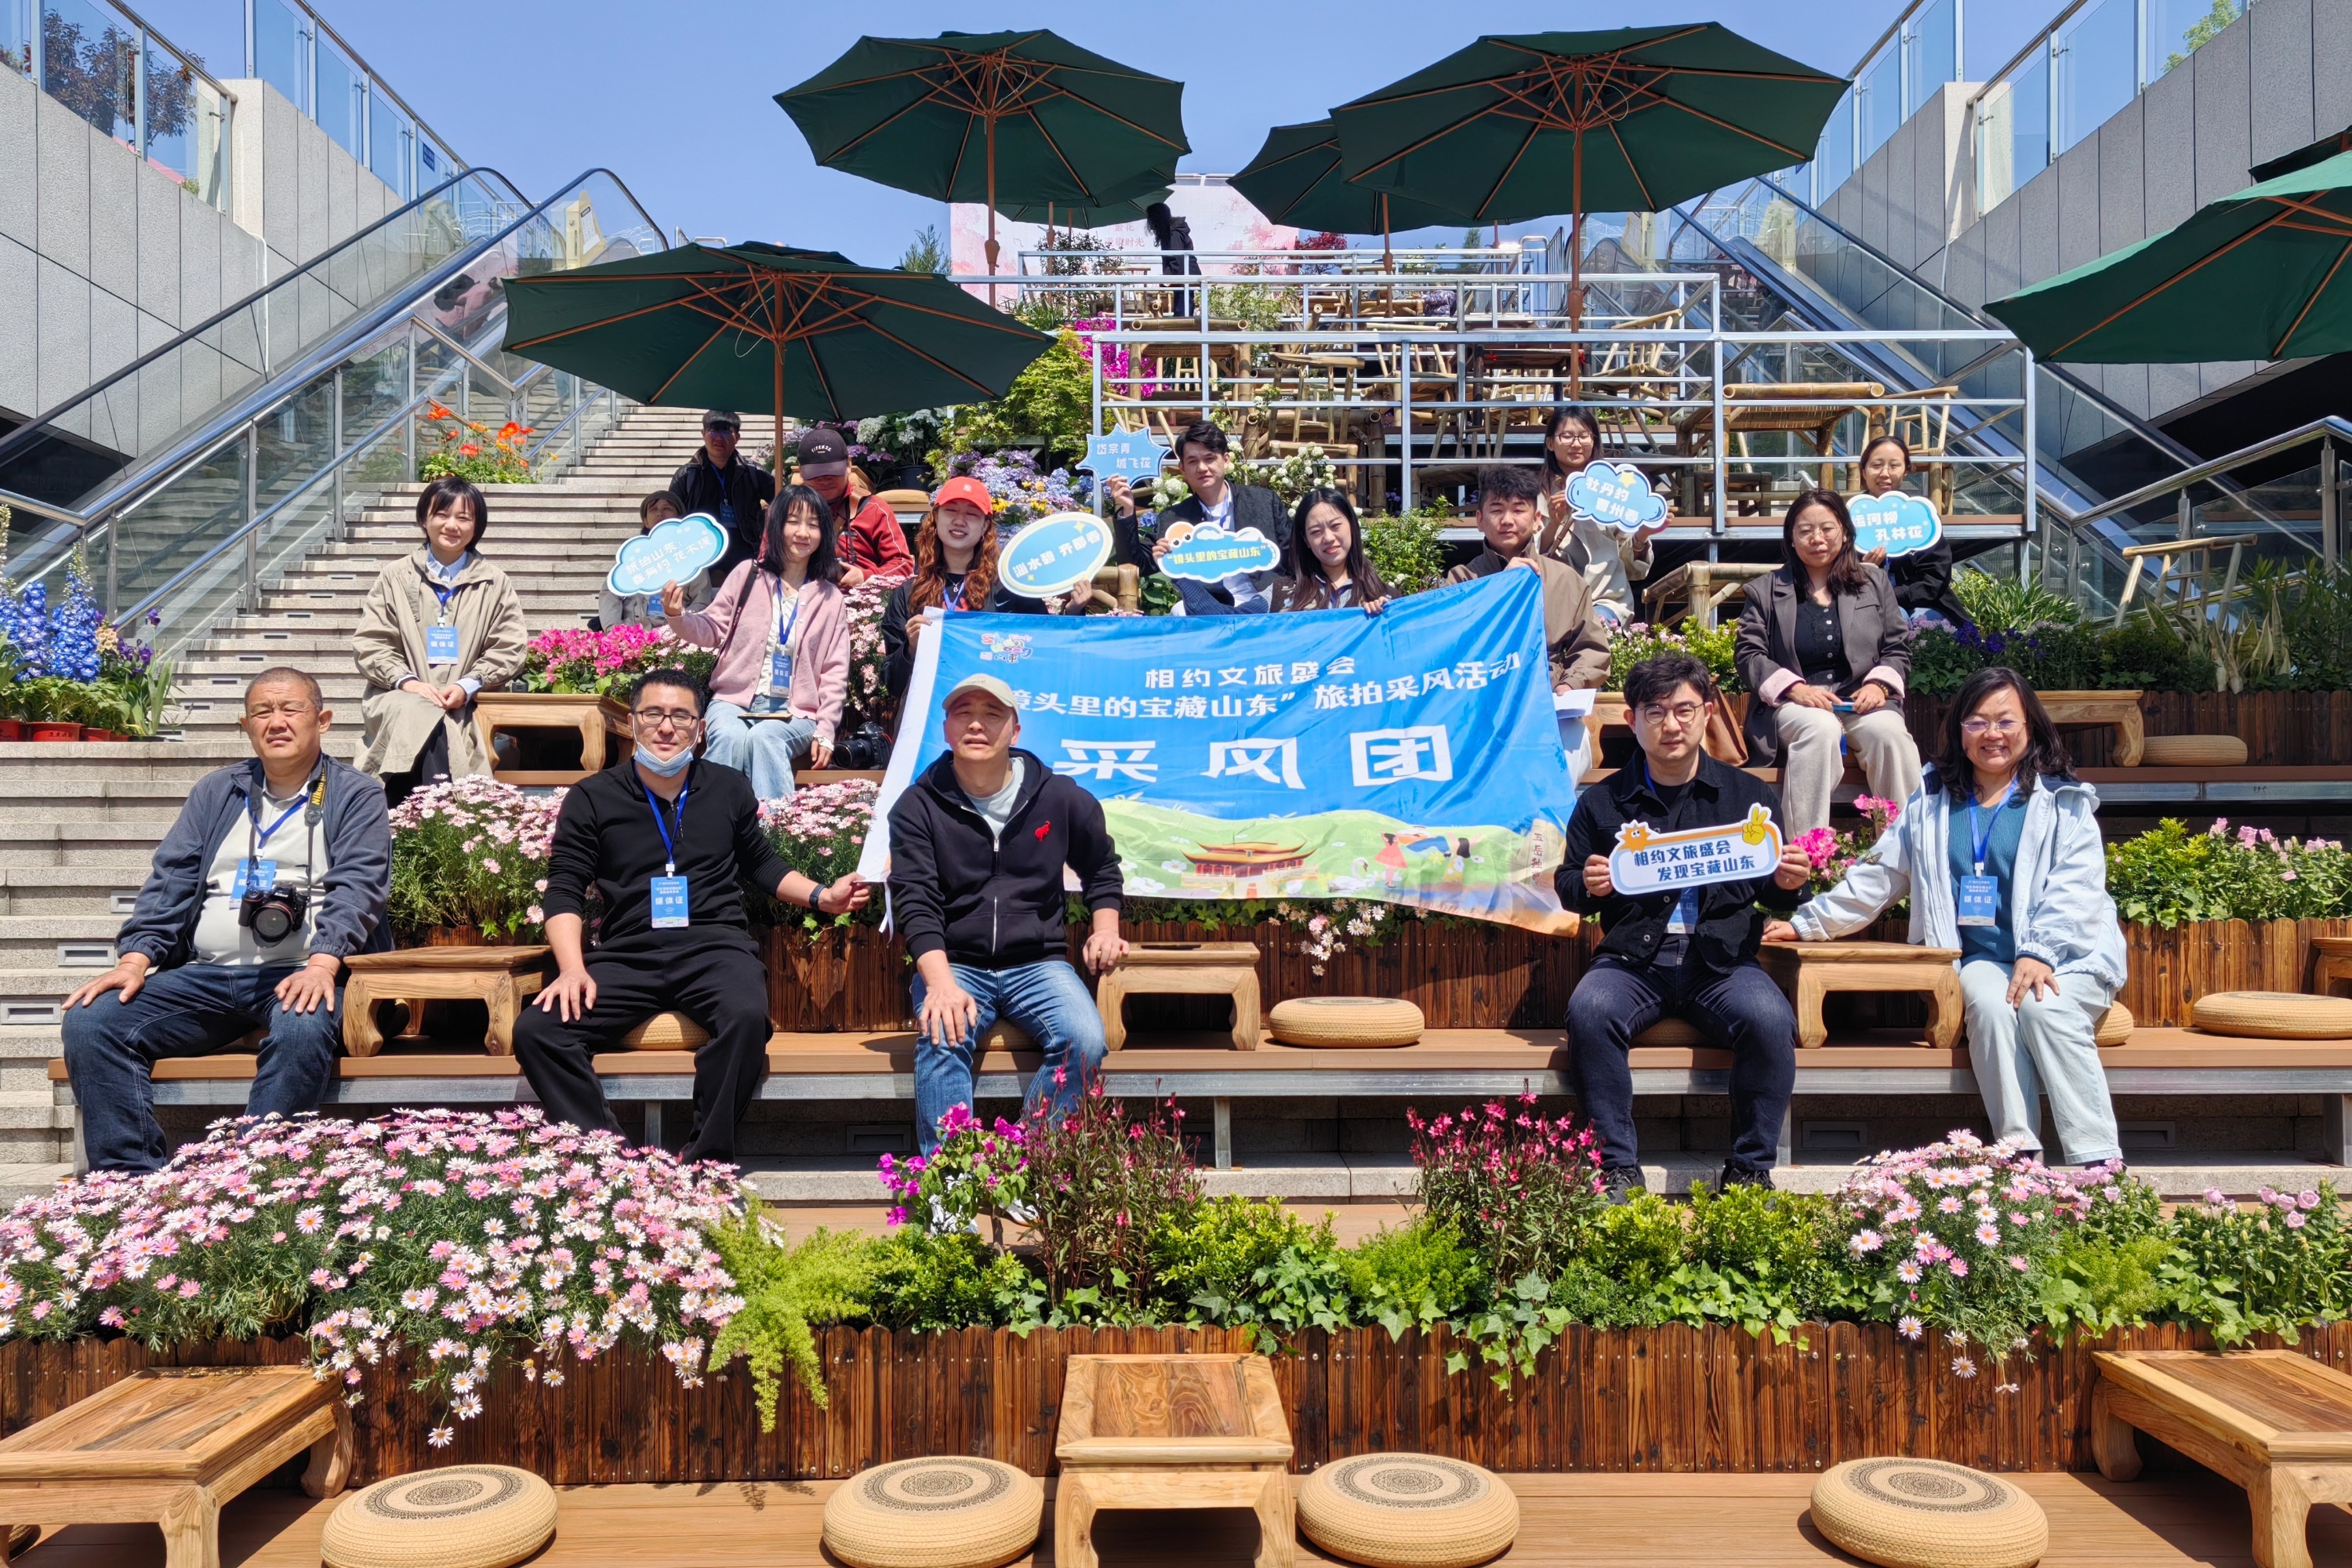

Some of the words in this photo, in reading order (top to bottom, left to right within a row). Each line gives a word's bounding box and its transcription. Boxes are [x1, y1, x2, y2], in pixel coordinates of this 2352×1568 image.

[1097, 442, 1131, 455] 岱宗青
[1116, 457, 1152, 470] 城飞花
[1585, 476, 1630, 502] 牡丹约
[1851, 510, 1898, 528] 运河柳
[1875, 525, 1923, 542] 孔林花
[1145, 655, 1356, 688] 相约文旅盛会
[1052, 724, 1453, 790] 采风团
[1634, 840, 1732, 867] 相约文旅盛会
[1657, 855, 1756, 882] 发现宝藏山东
